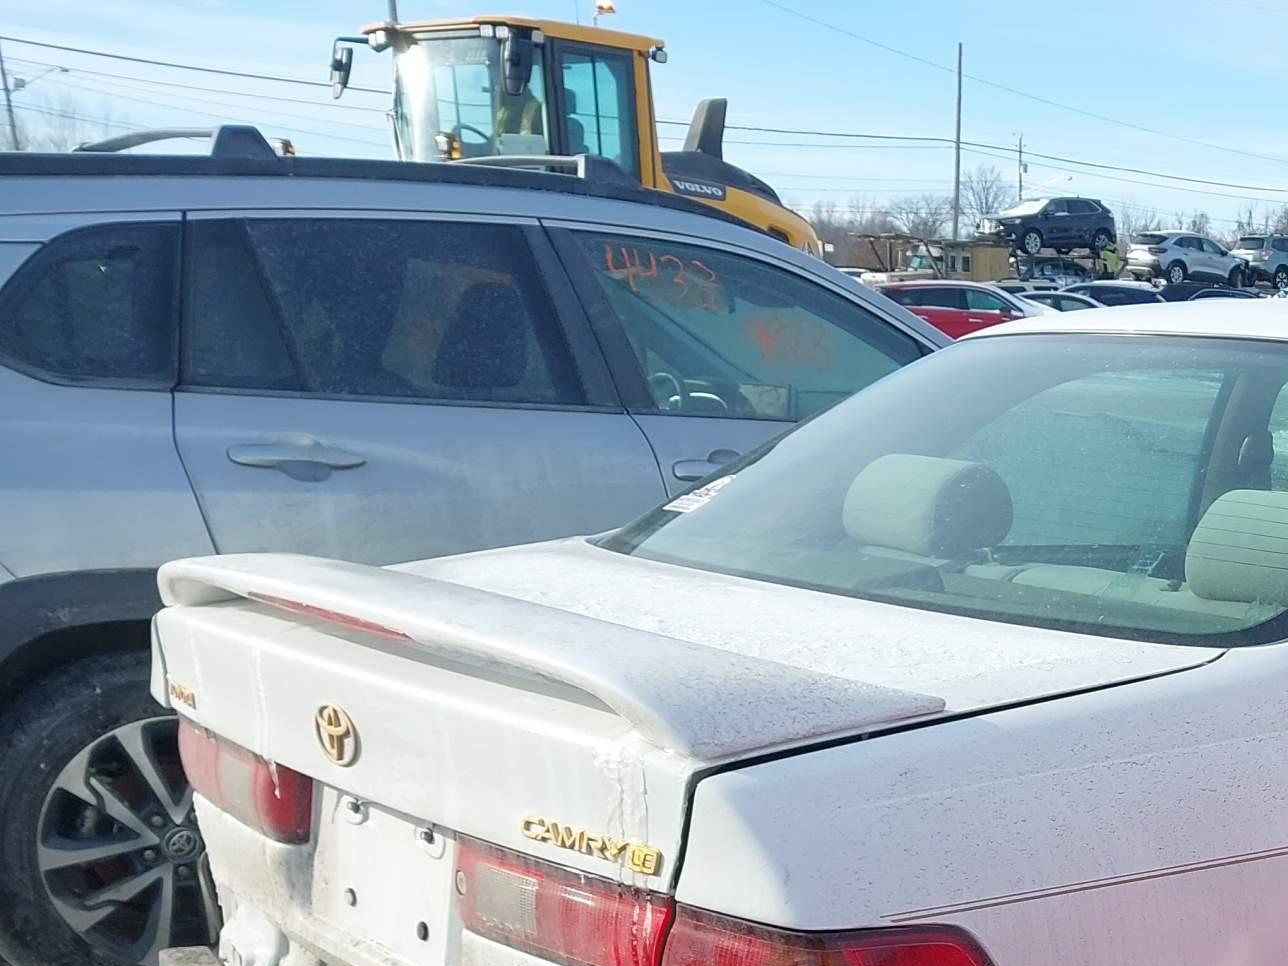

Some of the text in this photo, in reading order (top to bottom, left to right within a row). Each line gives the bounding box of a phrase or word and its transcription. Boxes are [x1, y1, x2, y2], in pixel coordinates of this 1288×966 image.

[673, 180, 723, 198] VOLVO
[521, 815, 657, 873] CAMRY LE
